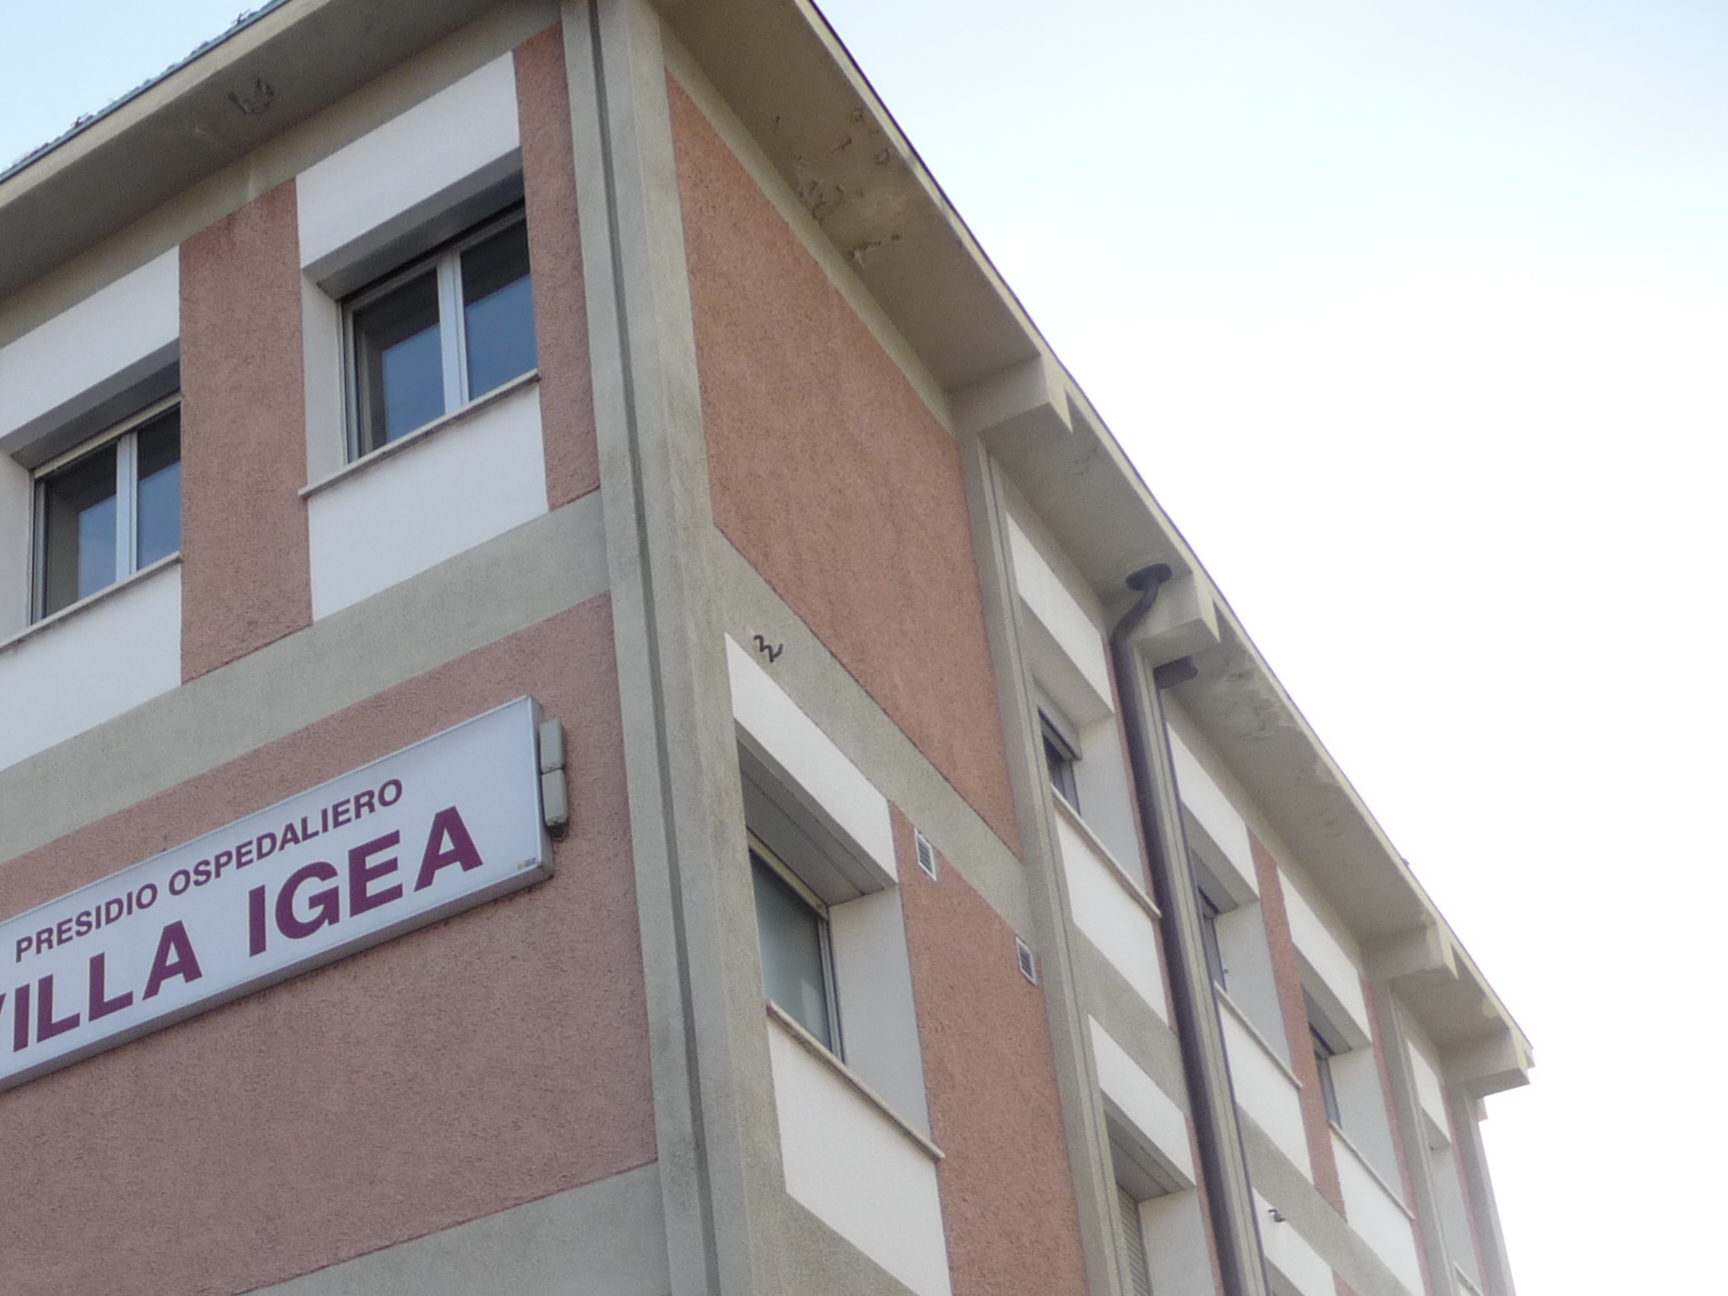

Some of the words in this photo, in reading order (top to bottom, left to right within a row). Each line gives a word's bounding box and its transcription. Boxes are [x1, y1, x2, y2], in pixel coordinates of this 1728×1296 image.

[15, 883, 158, 963] PRESIDIO
[168, 778, 403, 897] OSPEDALIERO
[248, 805, 483, 958] IGEA
